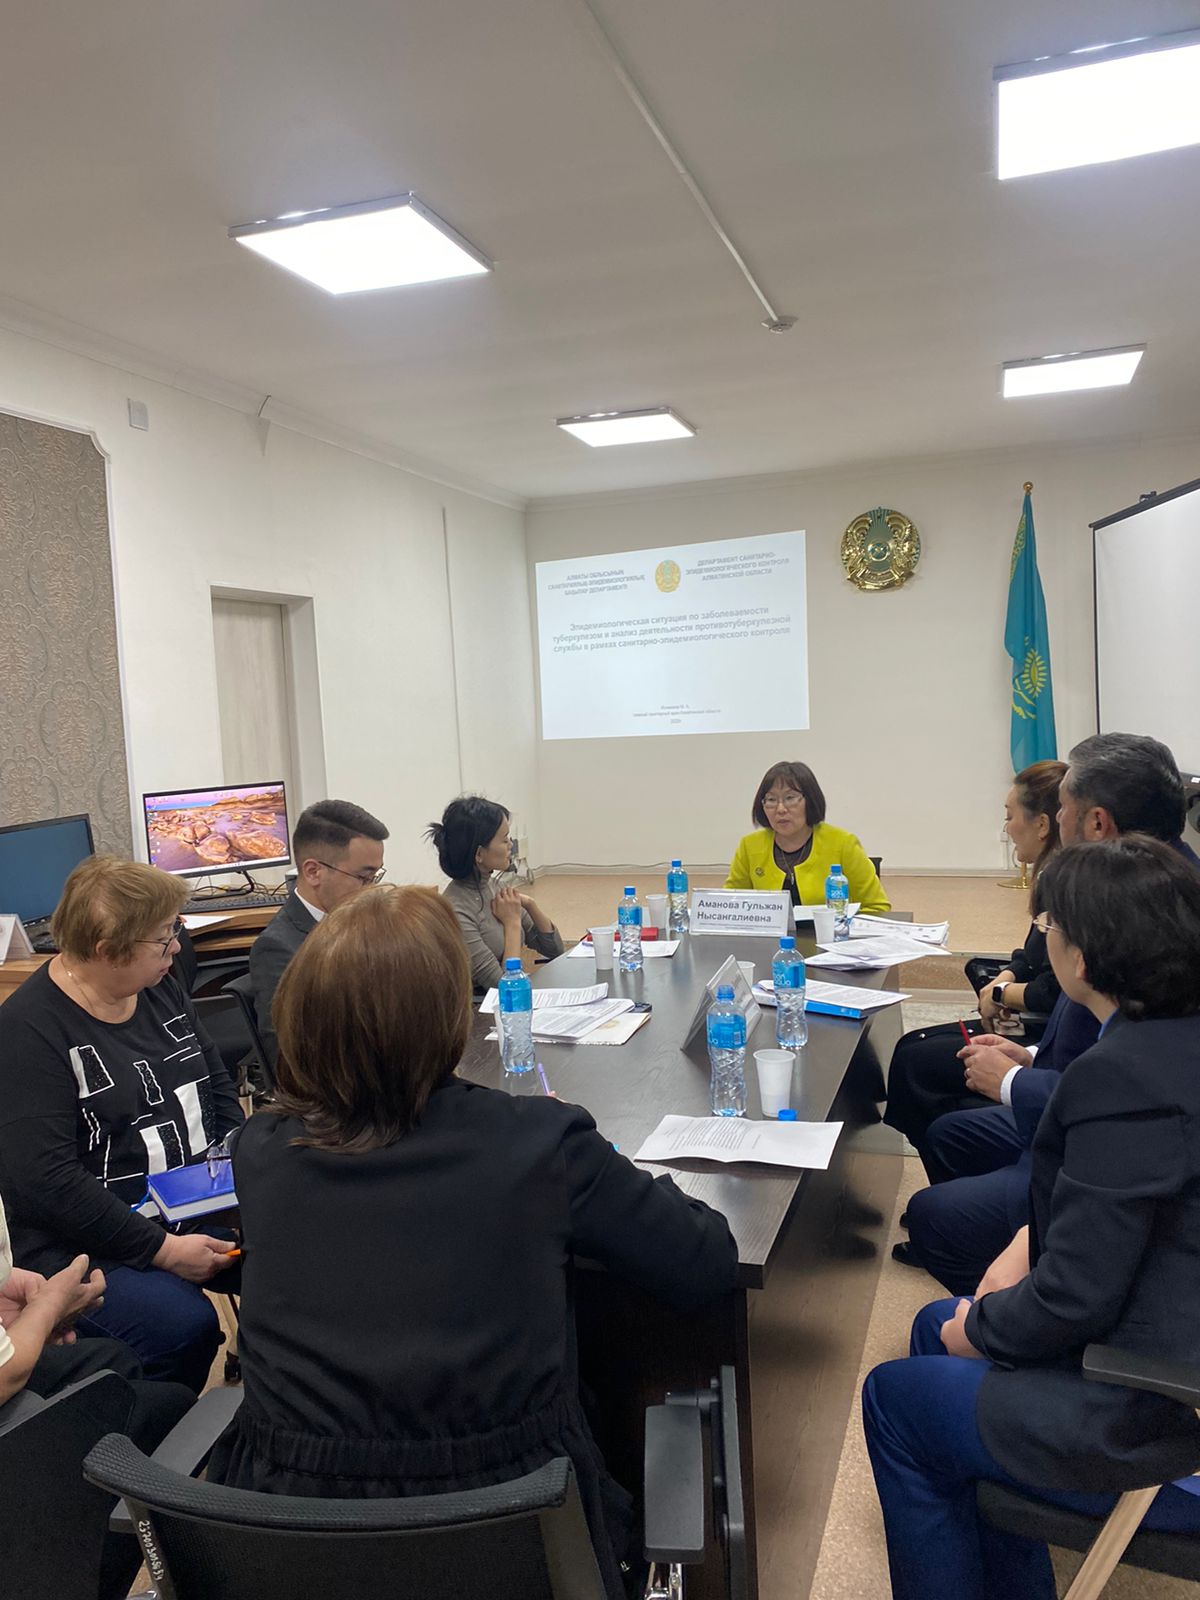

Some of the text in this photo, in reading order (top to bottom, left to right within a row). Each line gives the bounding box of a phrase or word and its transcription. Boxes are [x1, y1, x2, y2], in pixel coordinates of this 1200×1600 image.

[553, 634, 603, 643] туберкулезом
[611, 630, 637, 638] анализ
[638, 625, 693, 636] деятельности
[695, 615, 791, 631] противотуберкулезной
[570, 618, 650, 631] Эпидемиологическая
[651, 615, 687, 625] ситуация
[700, 608, 769, 620] заболеваемости
[553, 643, 582, 653] службы
[590, 642, 617, 651] рамках
[618, 632, 749, 647] санитарно-эпидемиологического
[750, 628, 790, 637] контроля
[697, 911, 772, 922] Нысангалиевна
[698, 899, 783, 911] Аманова Гульжан
